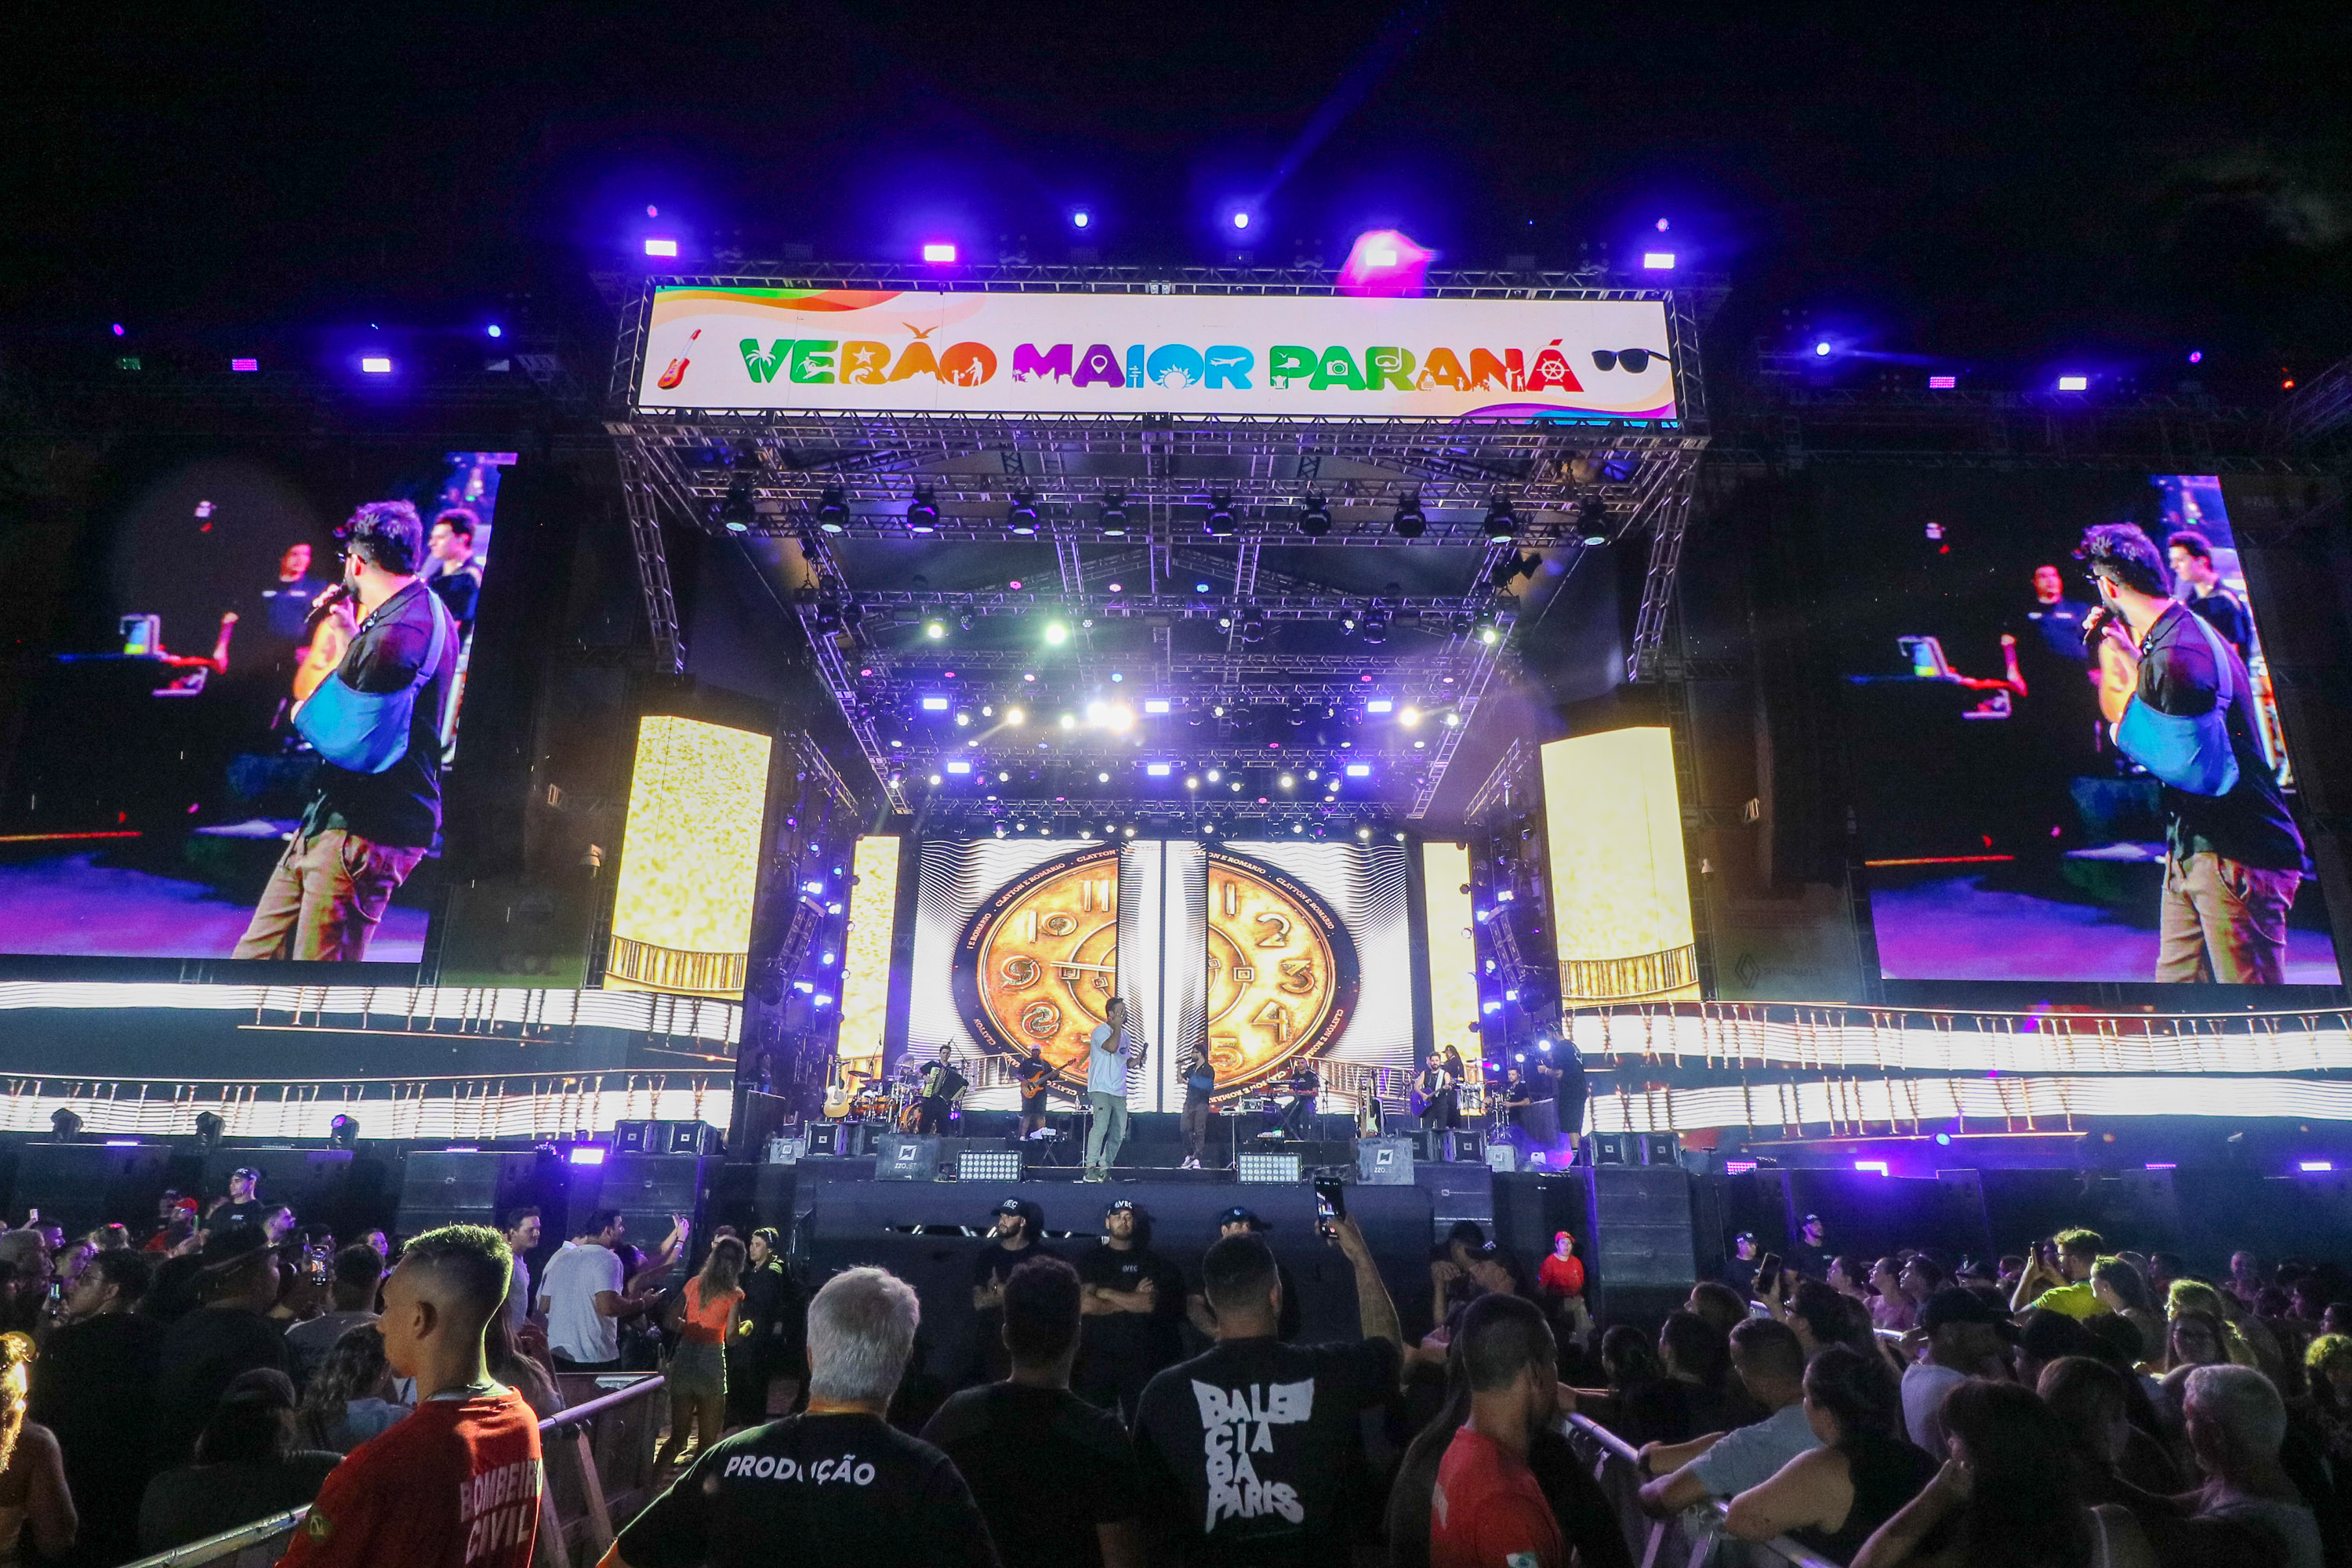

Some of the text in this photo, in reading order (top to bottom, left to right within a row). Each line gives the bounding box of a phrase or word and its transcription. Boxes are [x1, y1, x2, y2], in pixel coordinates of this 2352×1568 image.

[739, 322, 1584, 393] VERÃO MAIOR PARANÁ
[1076, 849, 1116, 862] CLAYTON
[1228, 856, 1266, 874] ROMARIO
[996, 883, 1025, 907] CLAYTON
[1029, 863, 1065, 883] ROMARIO
[1276, 877, 1307, 900] CLAYTON
[1310, 903, 1334, 930] ROMARIO
[972, 913, 992, 941] ROMARIO
[1028, 911, 1078, 944] 10
[1257, 913, 1290, 947] 2
[1000, 955, 1041, 991] 9
[1281, 960, 1315, 993] 3
[1252, 1001, 1288, 1042] 4
[1210, 1036, 1243, 1073] 5
[1303, 1041, 1325, 1059] ROMA
[1047, 1080, 1077, 1096] CLAYTO
[1209, 1090, 1244, 1104] ROMAR
[459, 1457, 543, 1523] BOMBEIRO
[1206, 1480, 1304, 1534] PARIS
[466, 1504, 530, 1566] CIVIL
